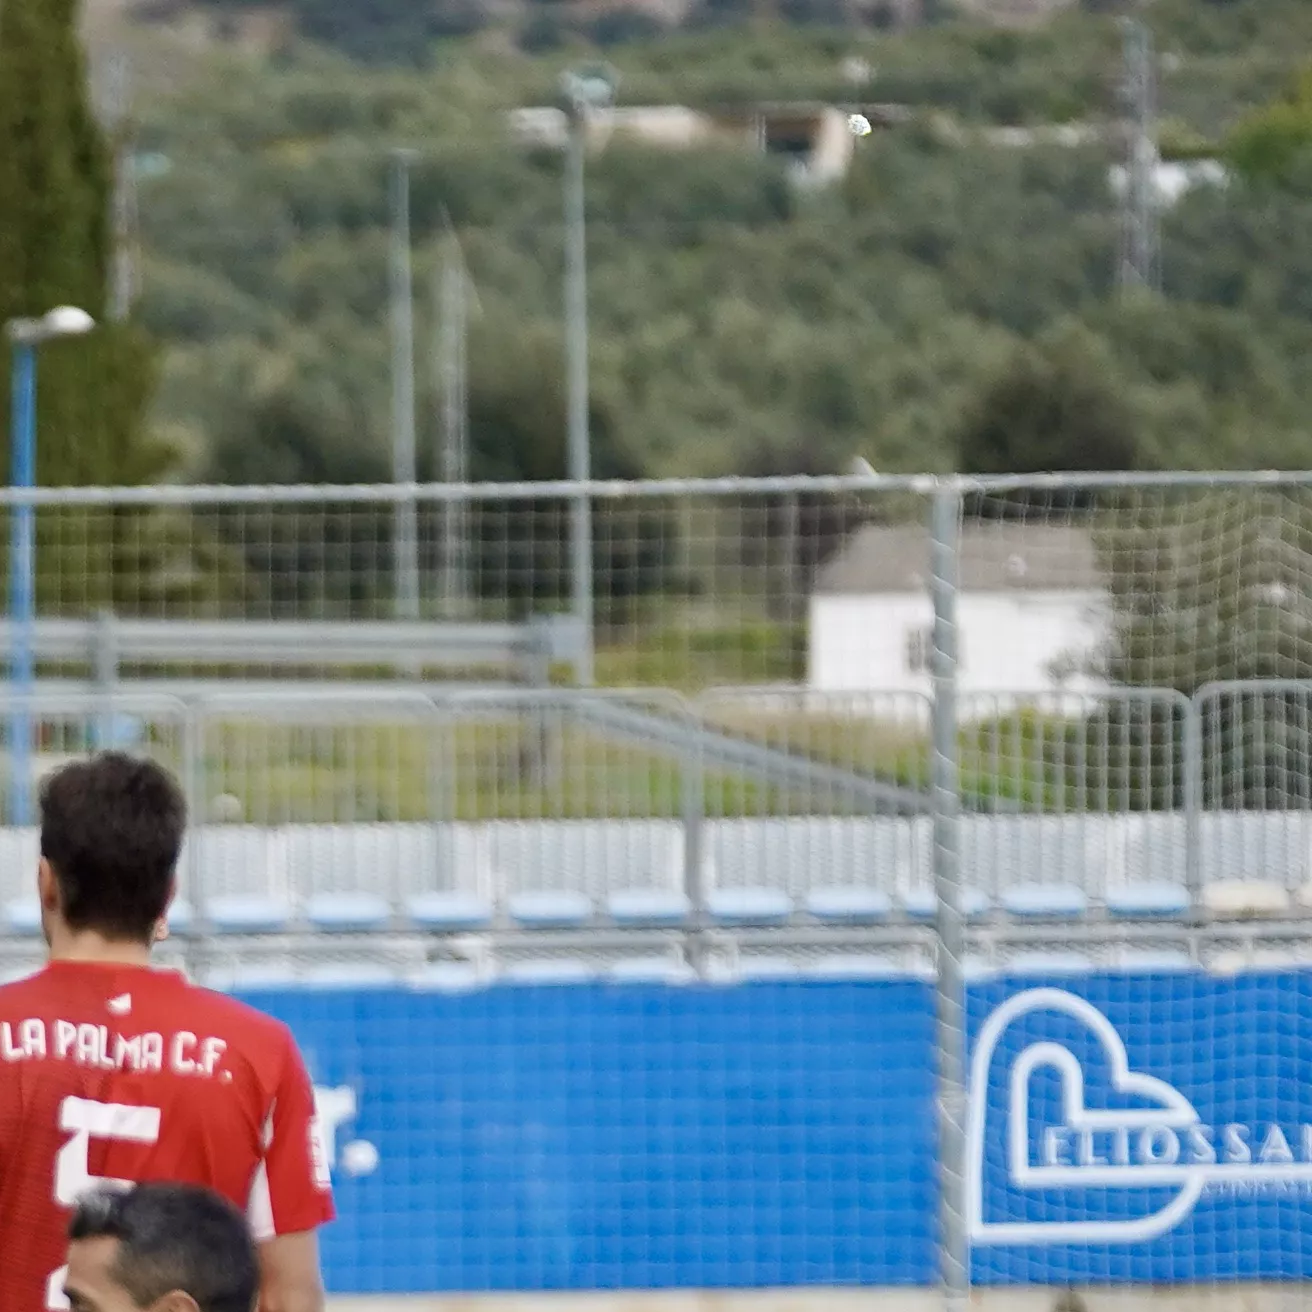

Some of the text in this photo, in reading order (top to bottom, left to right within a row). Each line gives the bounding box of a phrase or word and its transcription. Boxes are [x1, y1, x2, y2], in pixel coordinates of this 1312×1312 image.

[0, 1018, 233, 1084] LA PALMA C.F.
